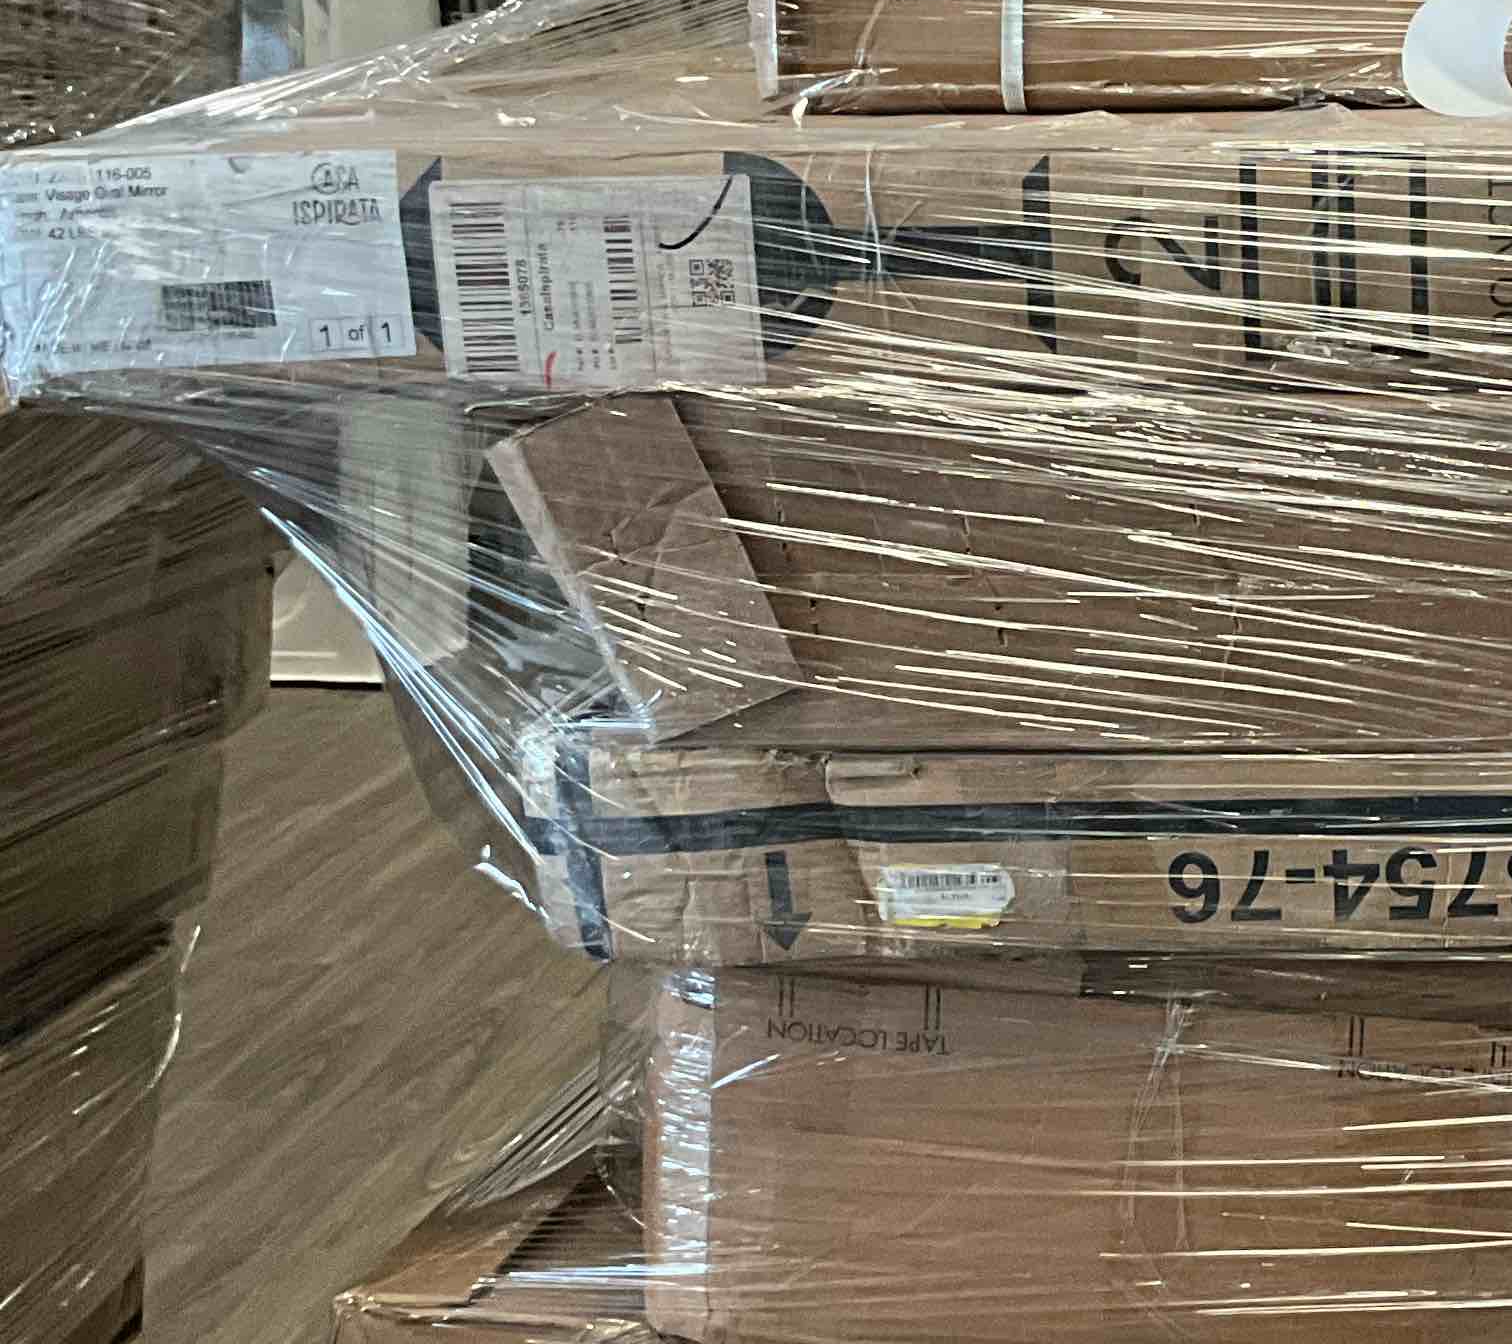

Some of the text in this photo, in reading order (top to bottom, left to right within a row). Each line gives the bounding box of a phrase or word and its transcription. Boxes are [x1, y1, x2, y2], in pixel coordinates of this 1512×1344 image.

[319, 321, 393, 348] 1 of 1
[766, 1015, 952, 1056] TAPE LOCATION
